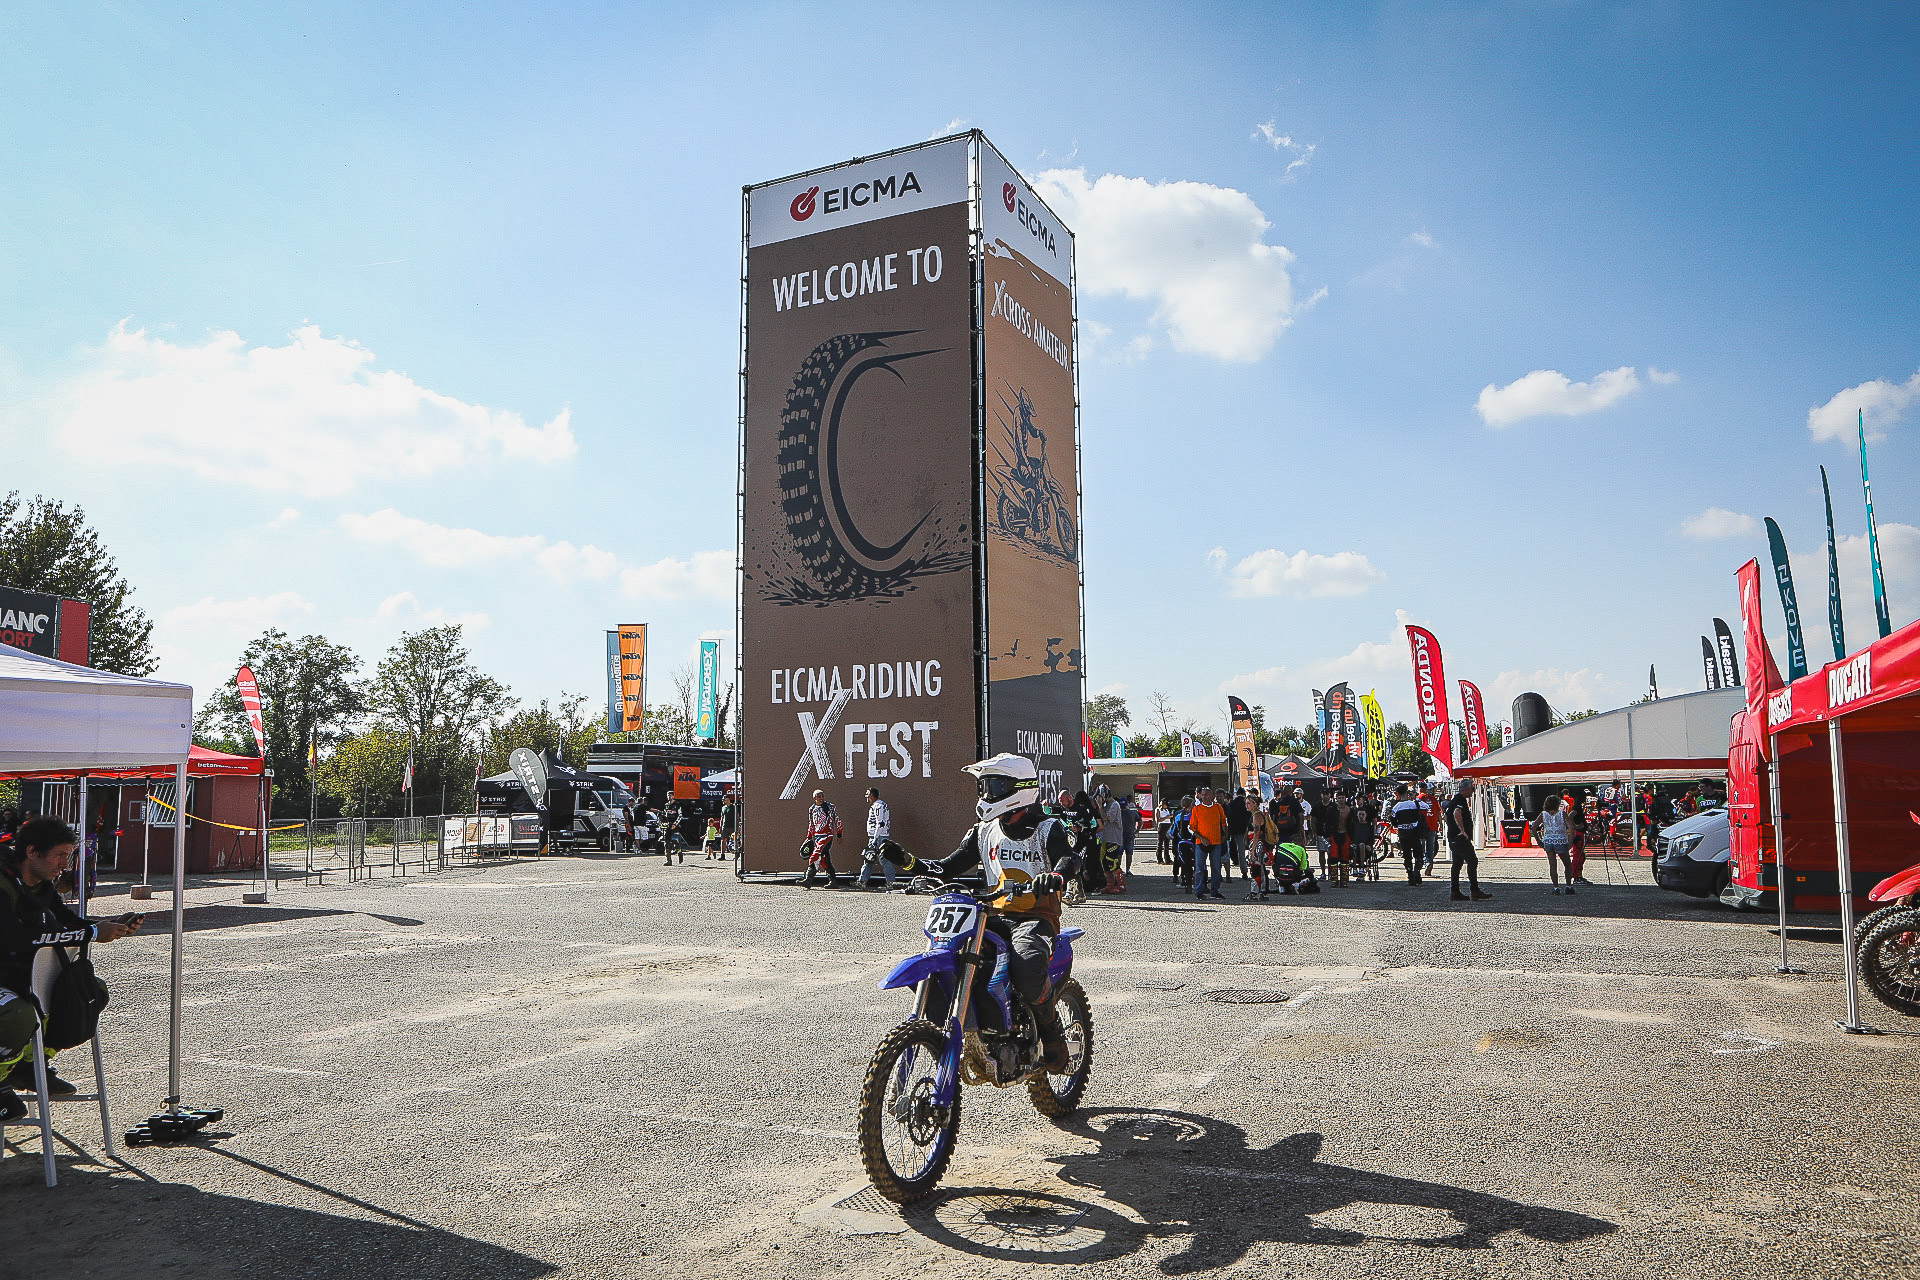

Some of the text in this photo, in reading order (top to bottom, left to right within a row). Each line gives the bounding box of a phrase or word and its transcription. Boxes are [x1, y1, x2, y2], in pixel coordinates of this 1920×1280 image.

[823, 171, 923, 215] EICMA
[1016, 198, 1058, 259] EICMA
[772, 245, 943, 313] WELCOME TO
[1032, 316, 1070, 372] AMATEUR
[0, 606, 49, 634] ANC
[1783, 587, 1805, 668] KOVE
[770, 659, 942, 704] EICMA RIDING
[1828, 650, 1872, 709] DUCATI
[1328, 691, 1345, 752] wheelup
[1767, 687, 1793, 728] DUCATI
[844, 720, 939, 779] FEST
[1016, 729, 1064, 756] EICMA RIDING
[677, 771, 697, 782] KTM
[1038, 769, 1063, 805] FEST
[1000, 848, 1043, 864] EICMA
[927, 906, 973, 934] 257
